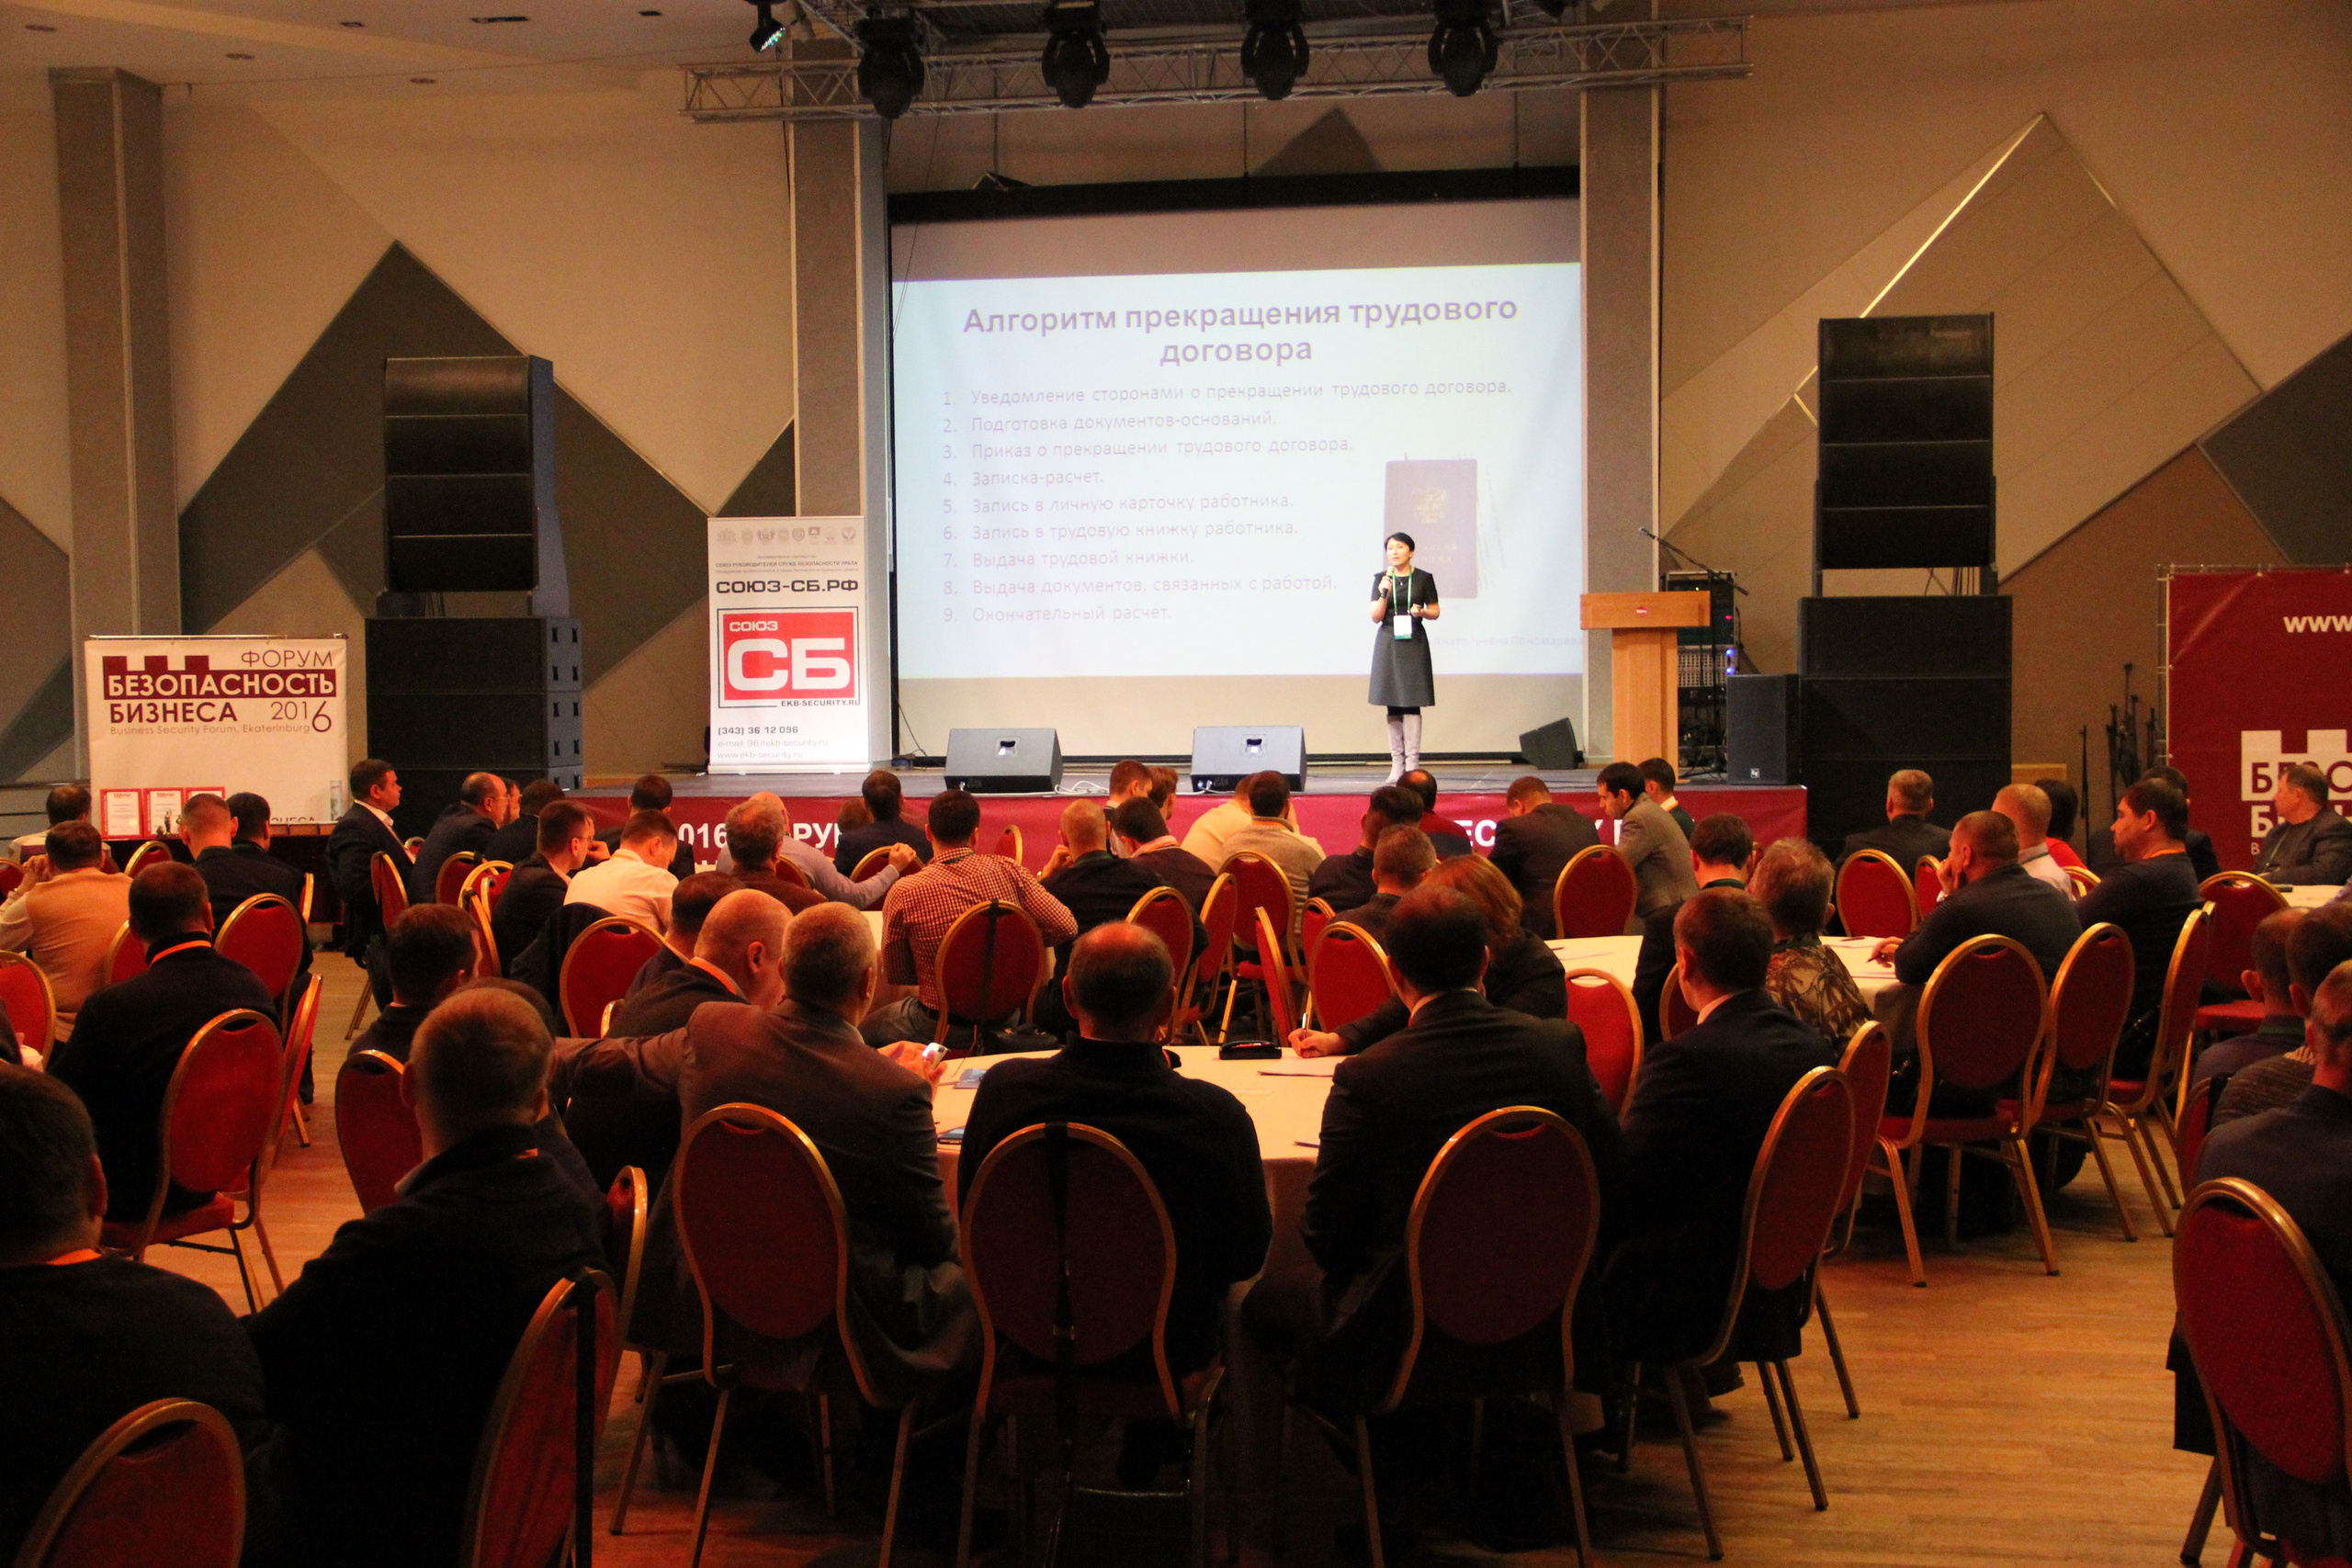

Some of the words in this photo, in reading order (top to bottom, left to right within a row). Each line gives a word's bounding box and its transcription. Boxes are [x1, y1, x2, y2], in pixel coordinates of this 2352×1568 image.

[963, 308, 1116, 336] Алгоритм
[1125, 304, 1340, 333] прекращения
[1349, 299, 1518, 328] трудового
[1159, 339, 1313, 367] договора
[943, 391, 956, 405] 1.
[971, 389, 1085, 404] Уведомление
[1091, 386, 1184, 402] сторонами
[1191, 389, 1200, 399] о
[1206, 384, 1323, 402] прекращении
[1332, 382, 1419, 399] трудового
[1424, 380, 1511, 397] договора.
[943, 419, 956, 433] 2.
[971, 416, 1068, 432] Подготовка
[1073, 411, 1276, 432] документов-оснований.
[943, 446, 956, 459] 3.
[972, 444, 1031, 461] Приказ
[1037, 446, 1046, 457] о
[1053, 442, 1168, 458] прекращении
[1176, 439, 1261, 457] трудового
[1268, 437, 1353, 454] договора.
[943, 472, 956, 486] 4.
[972, 470, 1103, 488] Записка-расчет.
[943, 500, 956, 513] 5.
[972, 499, 1029, 514] Запись
[1035, 502, 1045, 512] в
[1050, 500, 1113, 513] личную
[1119, 497, 1195, 513] карточку
[1201, 492, 1294, 512] работника.
[943, 525, 957, 540] 6.
[972, 525, 1029, 540] Запись
[1035, 528, 1045, 538] в
[1050, 525, 1130, 541] трудовую
[1136, 524, 1198, 540] книжку
[1204, 520, 1298, 538] работника.
[944, 553, 957, 568] 7.
[973, 553, 1035, 569] Выдача
[1042, 549, 1119, 567] трудовой
[1125, 550, 1193, 565] книжки.
[716, 579, 859, 593] СОЮЗ-СБ.РФ
[944, 581, 957, 595] 8.
[973, 580, 1035, 595] Выдача
[1041, 579, 1147, 594] документов,
[1153, 577, 1242, 592] связанных
[1249, 578, 1257, 590] с
[1262, 573, 1337, 592] работой.
[944, 608, 957, 622] 9.
[972, 604, 1105, 622] Окончательный
[1113, 606, 1171, 622] расчет.
[729, 620, 778, 632] СОЮЗ
[241, 649, 333, 668] ФОРУМ
[727, 637, 851, 691] СБ
[108, 673, 334, 696] БЕЗОПАСНОСТЬ
[781, 699, 861, 707] EKB-SECURITY.RU
[110, 702, 238, 724] БИЗНЕСА
[270, 700, 332, 733] 2016
[110, 726, 154, 735] Business
[157, 725, 199, 735] Security
[243, 724, 311, 735] Ekaterinburg
[718, 727, 744, 735] (343)
[748, 727, 761, 735] 36
[764, 727, 776, 735] 12
[779, 726, 798, 734] 096
[678, 822, 727, 848] 016
